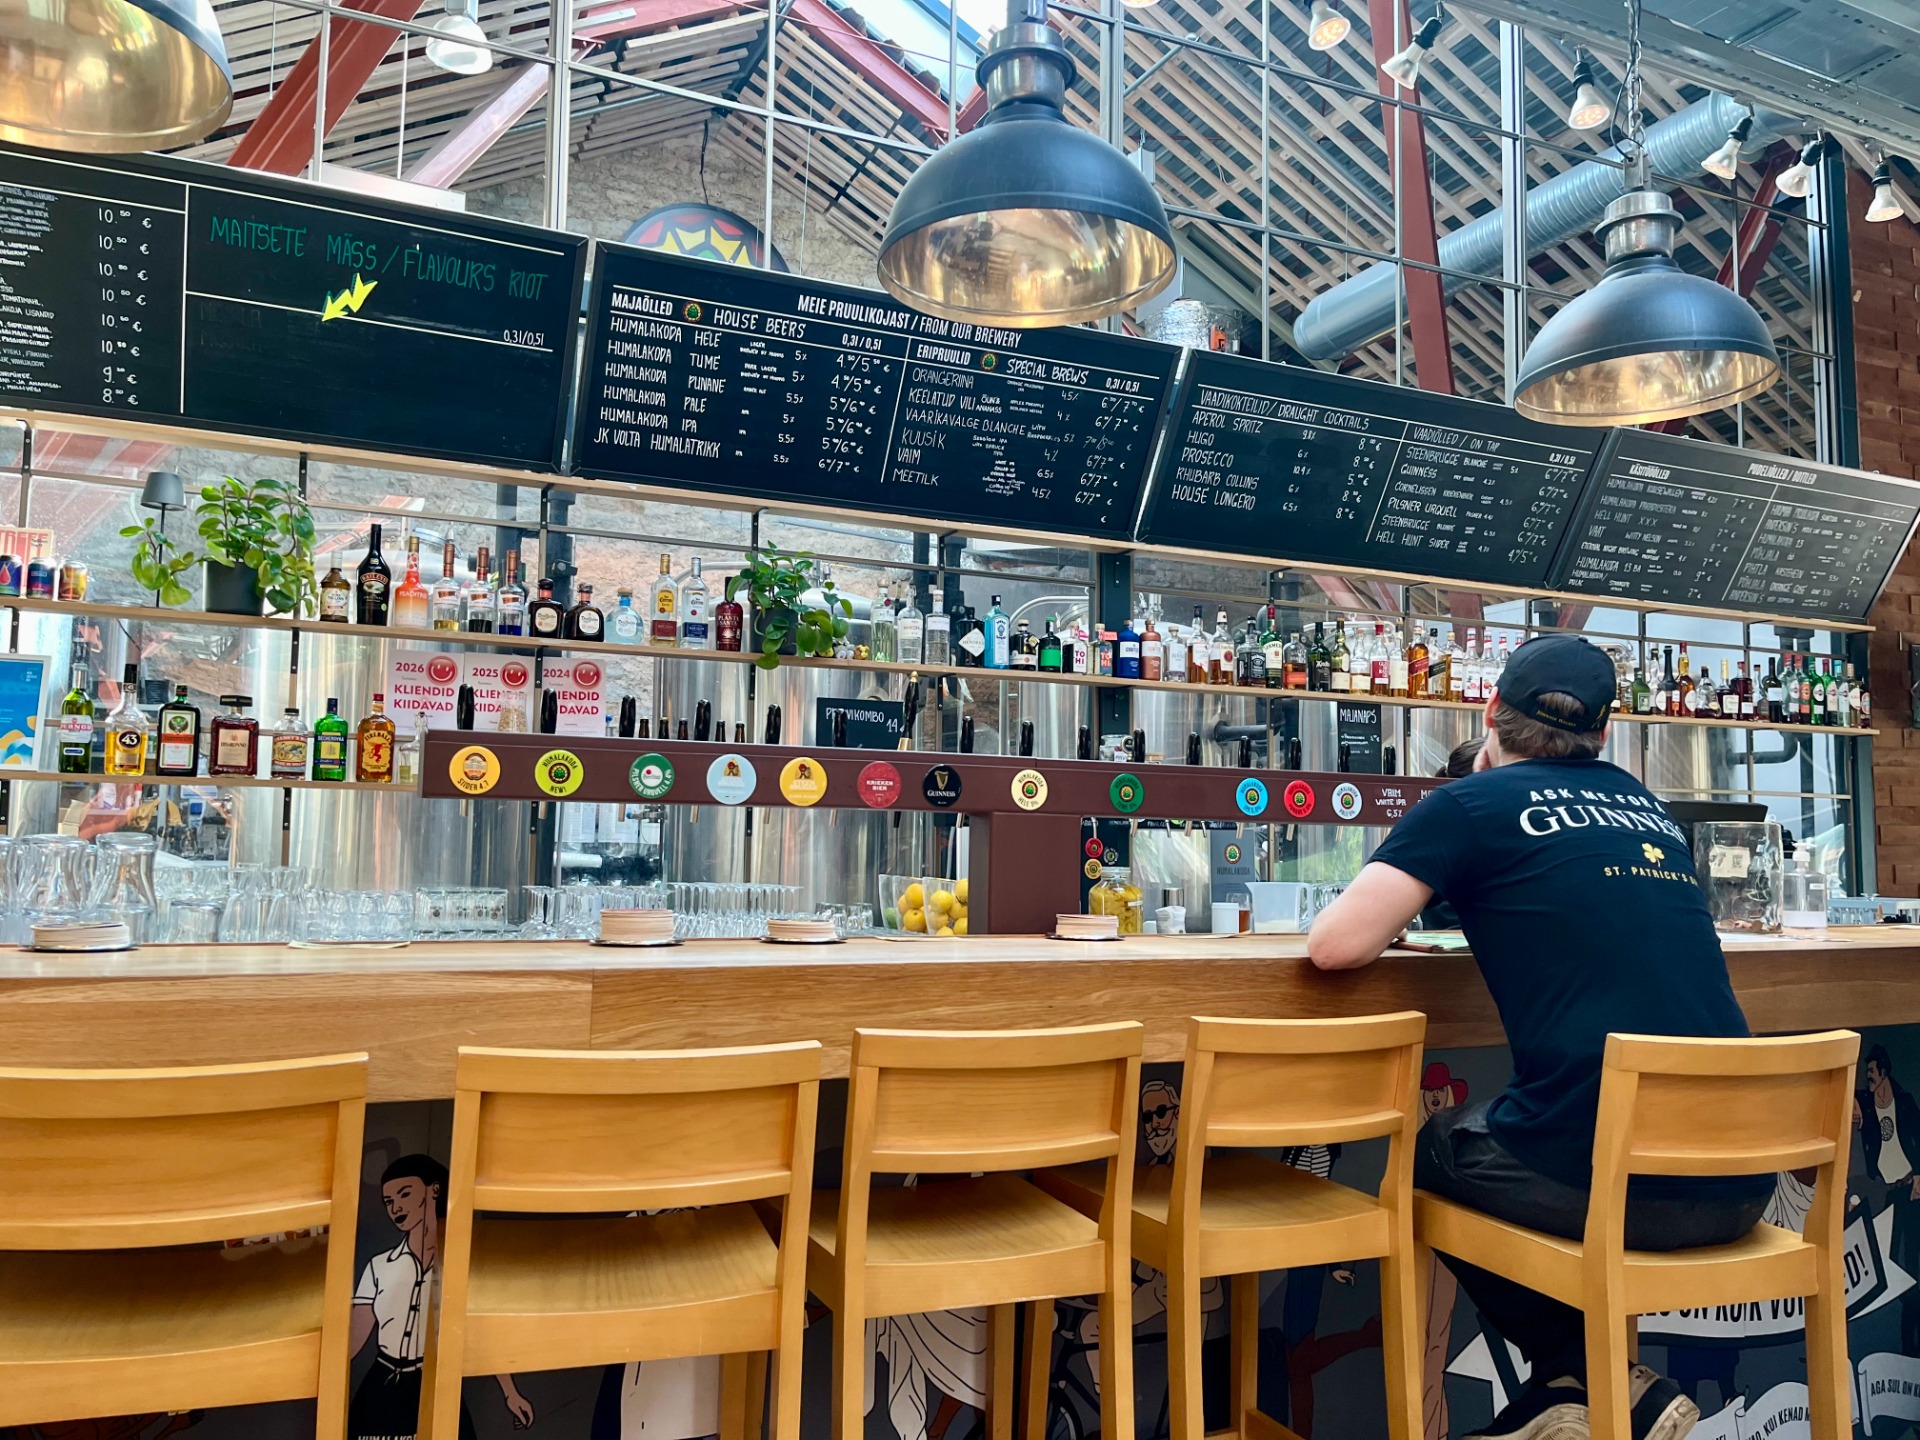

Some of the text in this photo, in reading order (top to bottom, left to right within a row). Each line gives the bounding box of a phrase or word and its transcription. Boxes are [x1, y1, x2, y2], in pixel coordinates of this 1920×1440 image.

[210, 216, 306, 257] MAITSETE
[403, 248, 496, 292] FLAVOURS
[509, 268, 549, 301] RIOT
[611, 292, 806, 339] MAJAÕLLED HOUSE BEERS
[798, 294, 1022, 348] MEIE PRUULIKOJAST FROM OUR BREWERY
[694, 330, 722, 347] HELE
[689, 353, 721, 371] TUME
[917, 344, 1089, 385] ERIPRUULID SPECIAL BREWS
[688, 375, 726, 394] PUNANE
[684, 396, 707, 413] PALE
[908, 387, 976, 411] KEELATUD VILI
[682, 418, 697, 433] IPA
[1192, 410, 1225, 429] APEROL
[1233, 417, 1263, 434] SPRITZ
[1278, 404, 1370, 431] DRAUGHT COCKTAILS
[982, 419, 1026, 435] BLANCHE
[593, 427, 610, 444] JK
[613, 429, 641, 448] VOLTA
[650, 433, 721, 459] HUMALATRIKK
[901, 427, 947, 450] KUUSIK
[1187, 430, 1215, 446] HUGO
[1470, 438, 1483, 450] ON
[1487, 440, 1500, 453] TAP
[897, 447, 921, 465] VAIM
[1181, 447, 1234, 468] PROSECCO
[1176, 466, 1221, 487] RHUBARB
[1225, 473, 1259, 490] COLLINS
[1400, 463, 1438, 479] GUINNESS
[1171, 484, 1209, 504] HOUSE
[1214, 490, 1256, 511] LONGERO
[1388, 497, 1421, 512] PILSNER
[1376, 530, 1395, 543] HELL
[1401, 533, 1424, 547] HUNT
[395, 662, 424, 673] 2026
[472, 667, 499, 677] 2025
[543, 668, 570, 678] 2024
[394, 684, 455, 698] KLIENDID
[557, 691, 600, 701] IENDID
[393, 699, 454, 712] KIIDAVAD
[121, 734, 138, 745] 43
[927, 790, 956, 798] GUINNESS
[1530, 788, 1575, 803] ASK
[1580, 789, 1612, 803] ME
[1615, 793, 1653, 809] FOR
[1604, 866, 1626, 876] ST.
[1631, 866, 1688, 882] PATRICK'S
[1871, 1382, 1886, 1397] AGA
[1887, 1379, 1901, 1394] SUL
[1902, 1381, 1913, 1395] ON
[1763, 1417, 1778, 1436] KUI
[1778, 1407, 1804, 1426] KENAD
